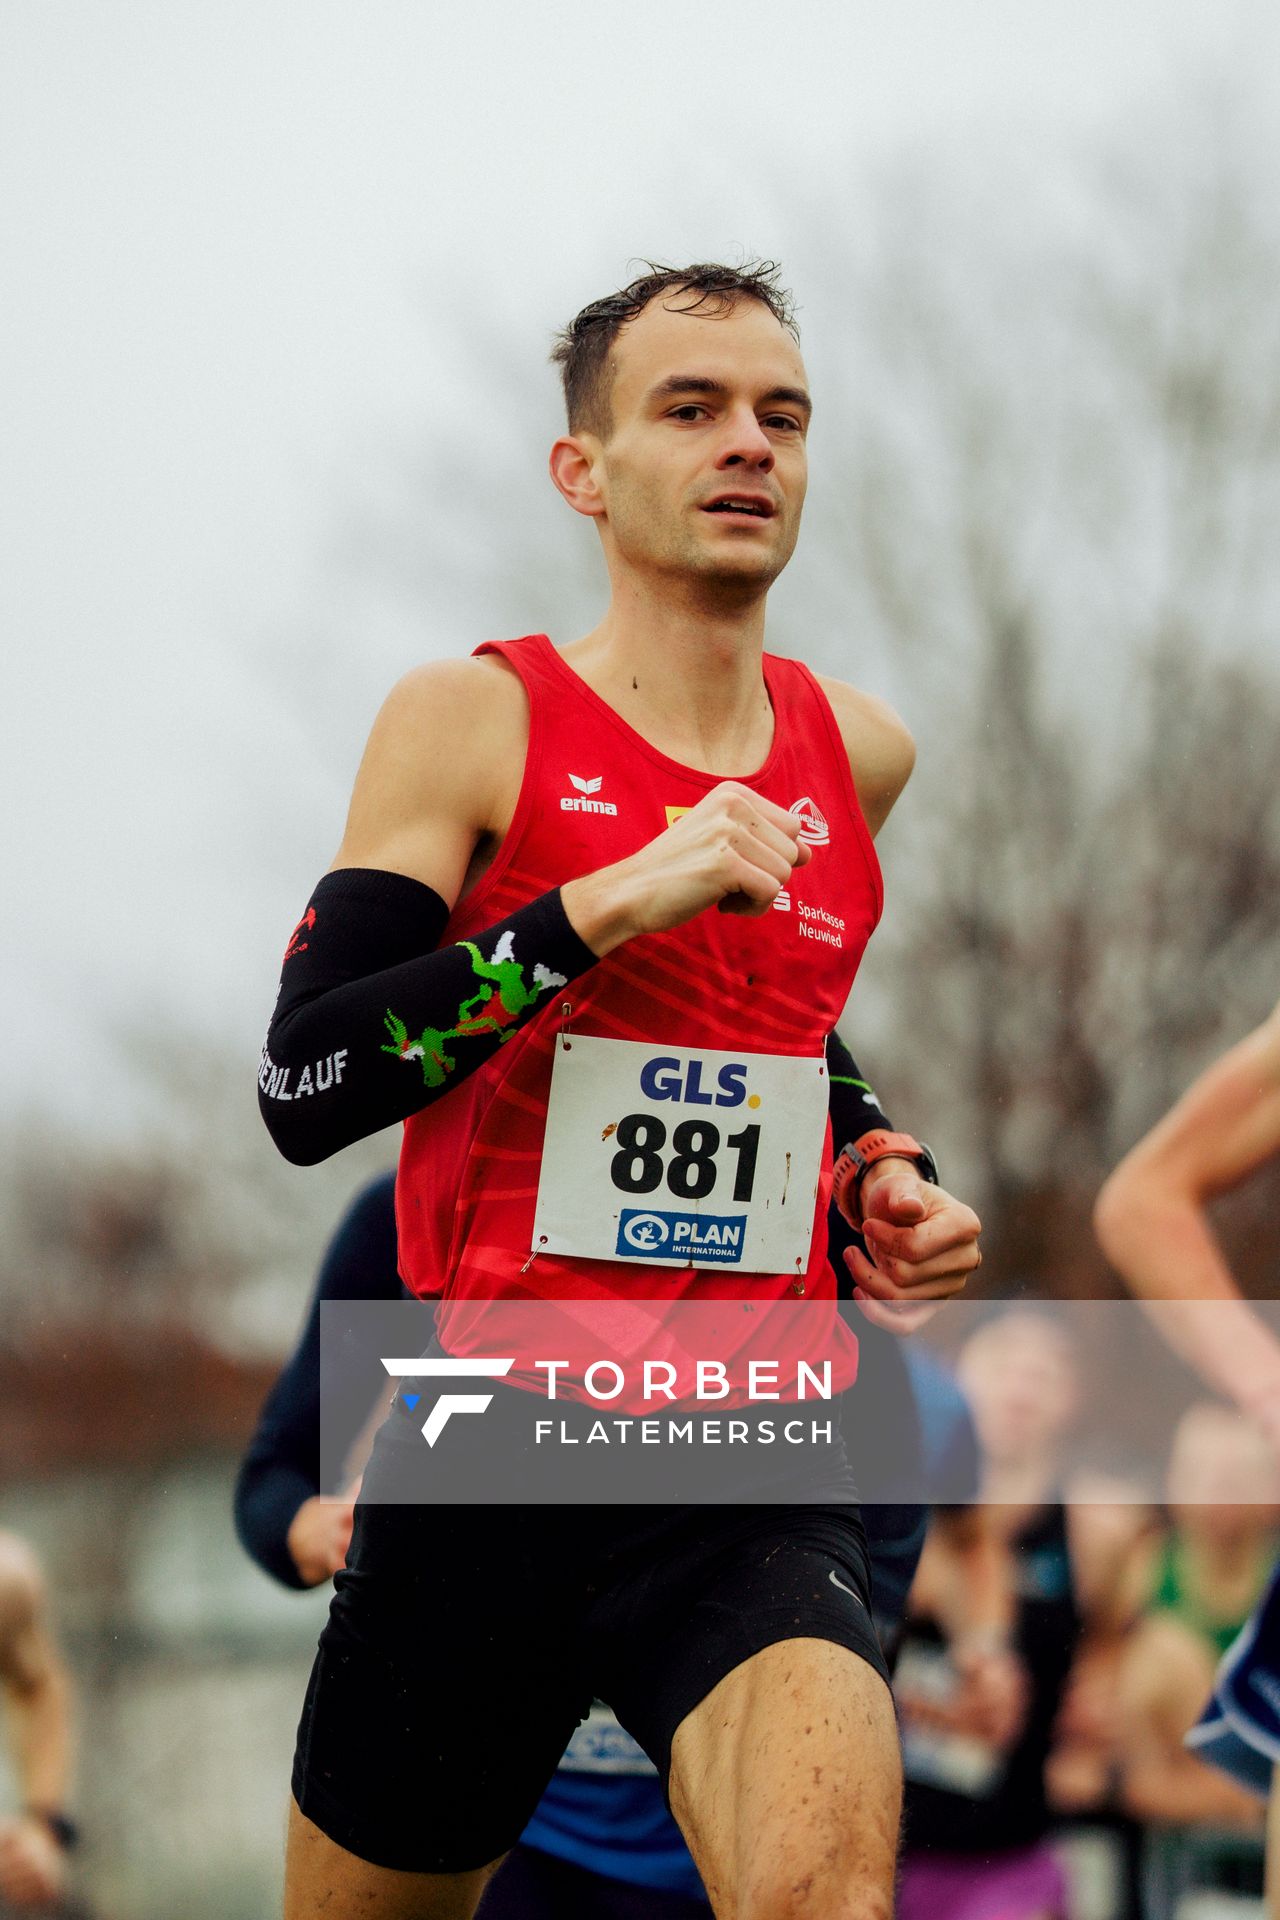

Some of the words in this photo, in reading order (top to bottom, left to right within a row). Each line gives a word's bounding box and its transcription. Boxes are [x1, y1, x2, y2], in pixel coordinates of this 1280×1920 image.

[560, 796, 618, 816] erima
[797, 900, 846, 931] Sparkasse
[799, 921, 843, 949] Neuwied
[610, 1113, 761, 1203] 881
[673, 1221, 741, 1247] PLAN
[672, 1245, 737, 1257] INTERNATIONAL
